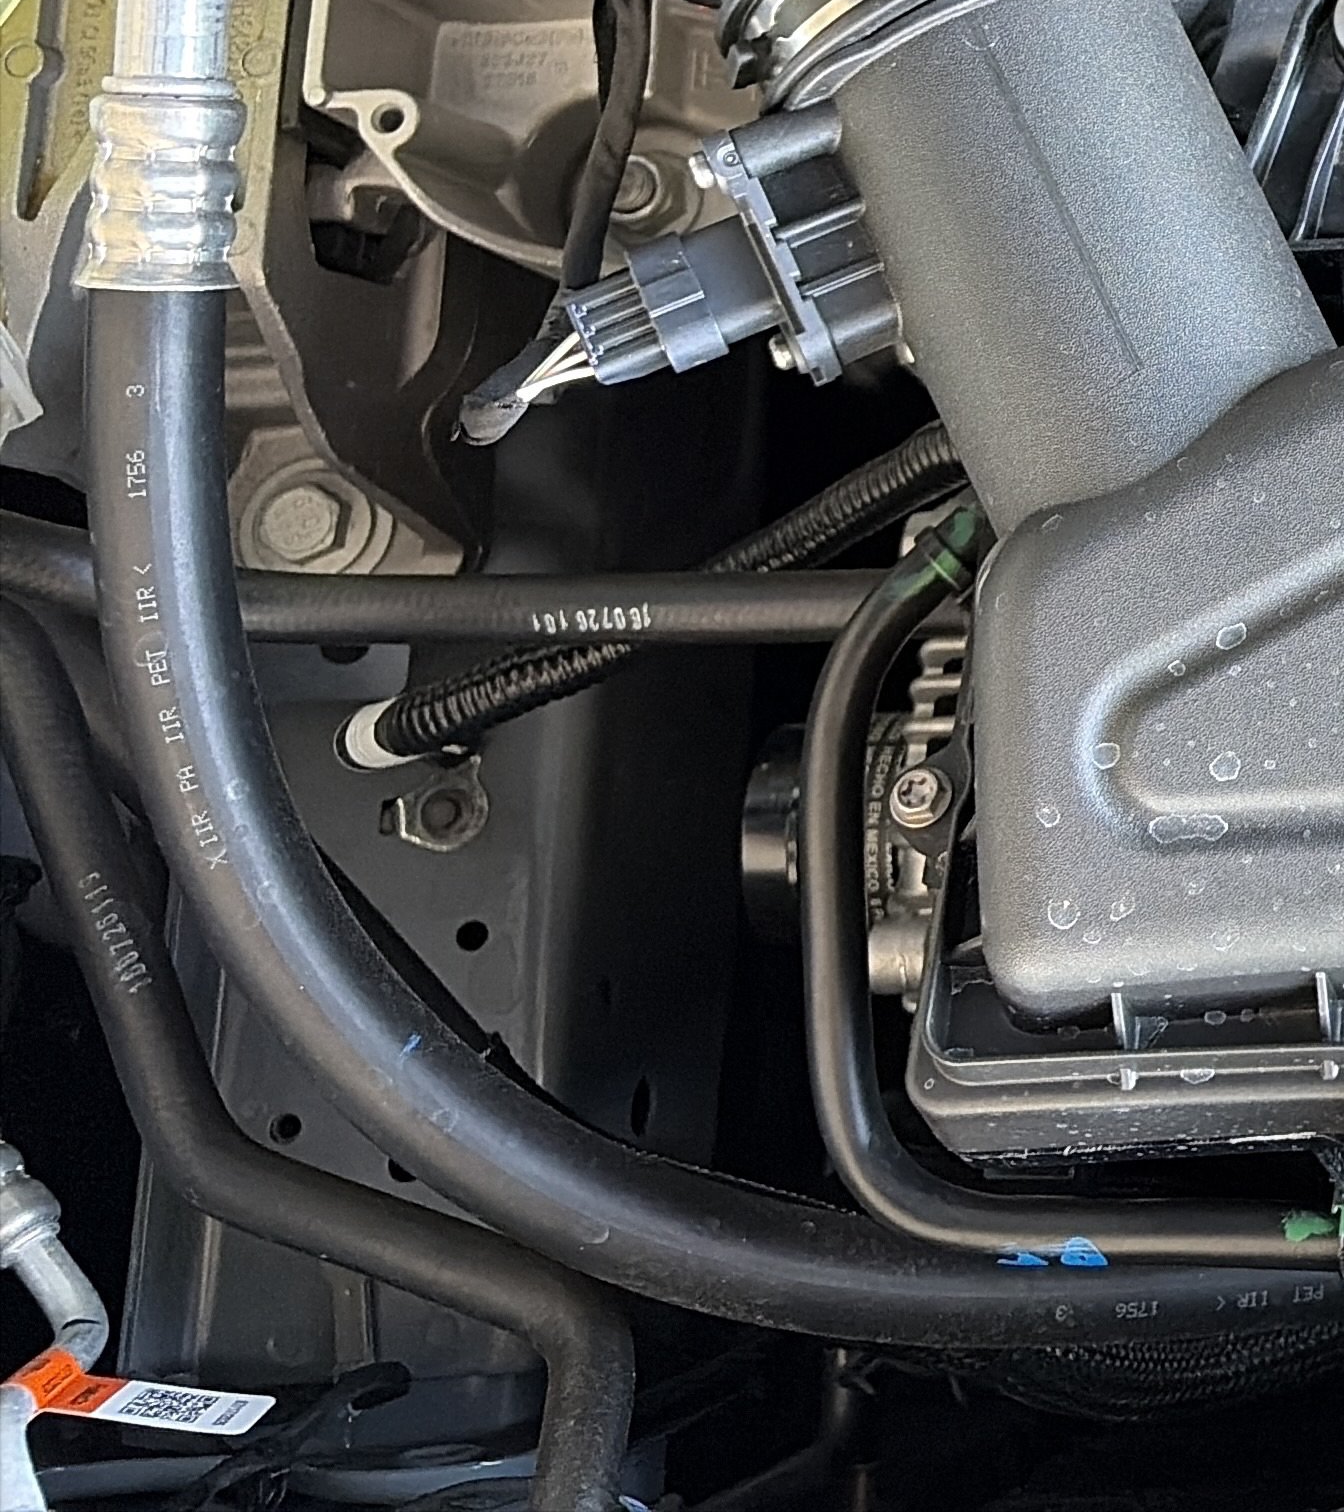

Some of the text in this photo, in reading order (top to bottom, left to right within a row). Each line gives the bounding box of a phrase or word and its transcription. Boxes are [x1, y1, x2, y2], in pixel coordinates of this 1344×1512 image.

[126, 384, 145, 397] 3
[126, 449, 146, 499] 1756
[149, 649, 171, 687] PET
[179, 764, 200, 795] PA
[866, 829, 881, 892] MEXICO
[1290, 1281, 1325, 1305] PET
[1113, 1300, 1160, 1321] 1756
